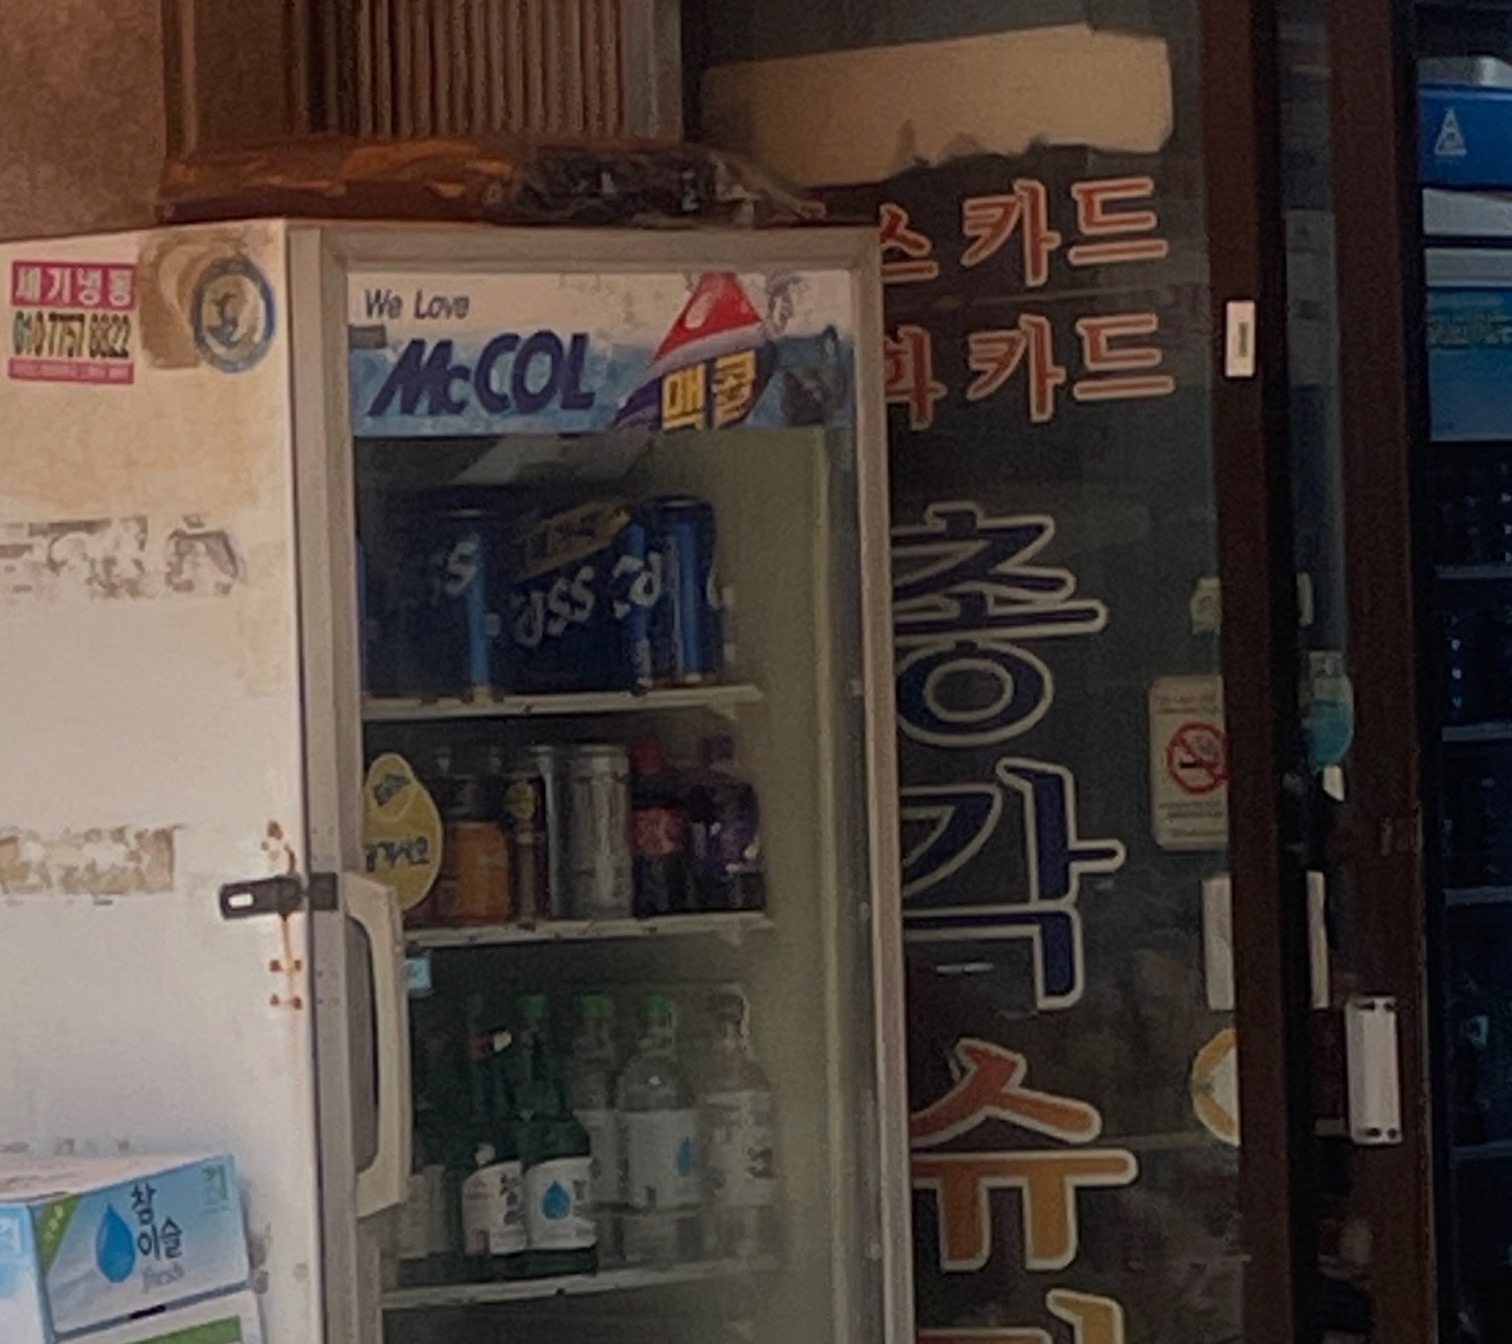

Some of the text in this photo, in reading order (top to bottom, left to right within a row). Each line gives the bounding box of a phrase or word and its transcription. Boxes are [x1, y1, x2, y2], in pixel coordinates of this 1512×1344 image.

[364, 288, 470, 319] We Love
[14, 311, 47, 357] 010
[368, 330, 596, 417] McCOL
